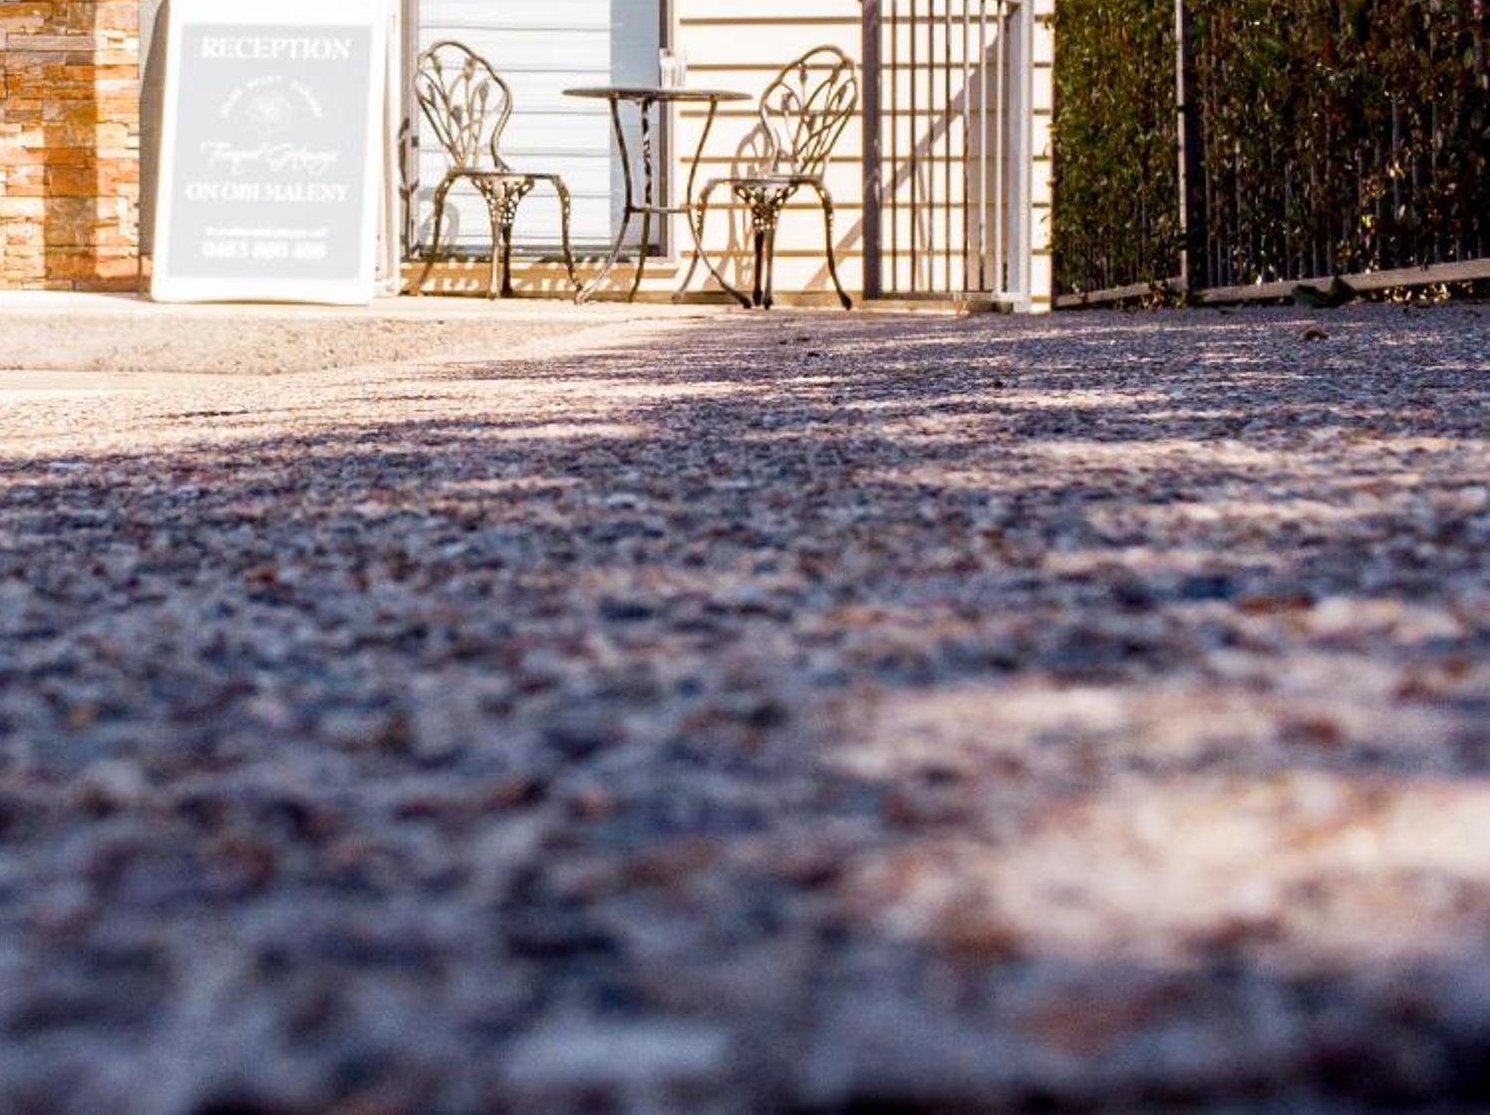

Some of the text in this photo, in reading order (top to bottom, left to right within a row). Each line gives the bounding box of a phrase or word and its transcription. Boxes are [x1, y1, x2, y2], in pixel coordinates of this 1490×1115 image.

[200, 36, 353, 60] RECEPTION
[185, 181, 219, 202] ON
[264, 181, 351, 202] MALENY
